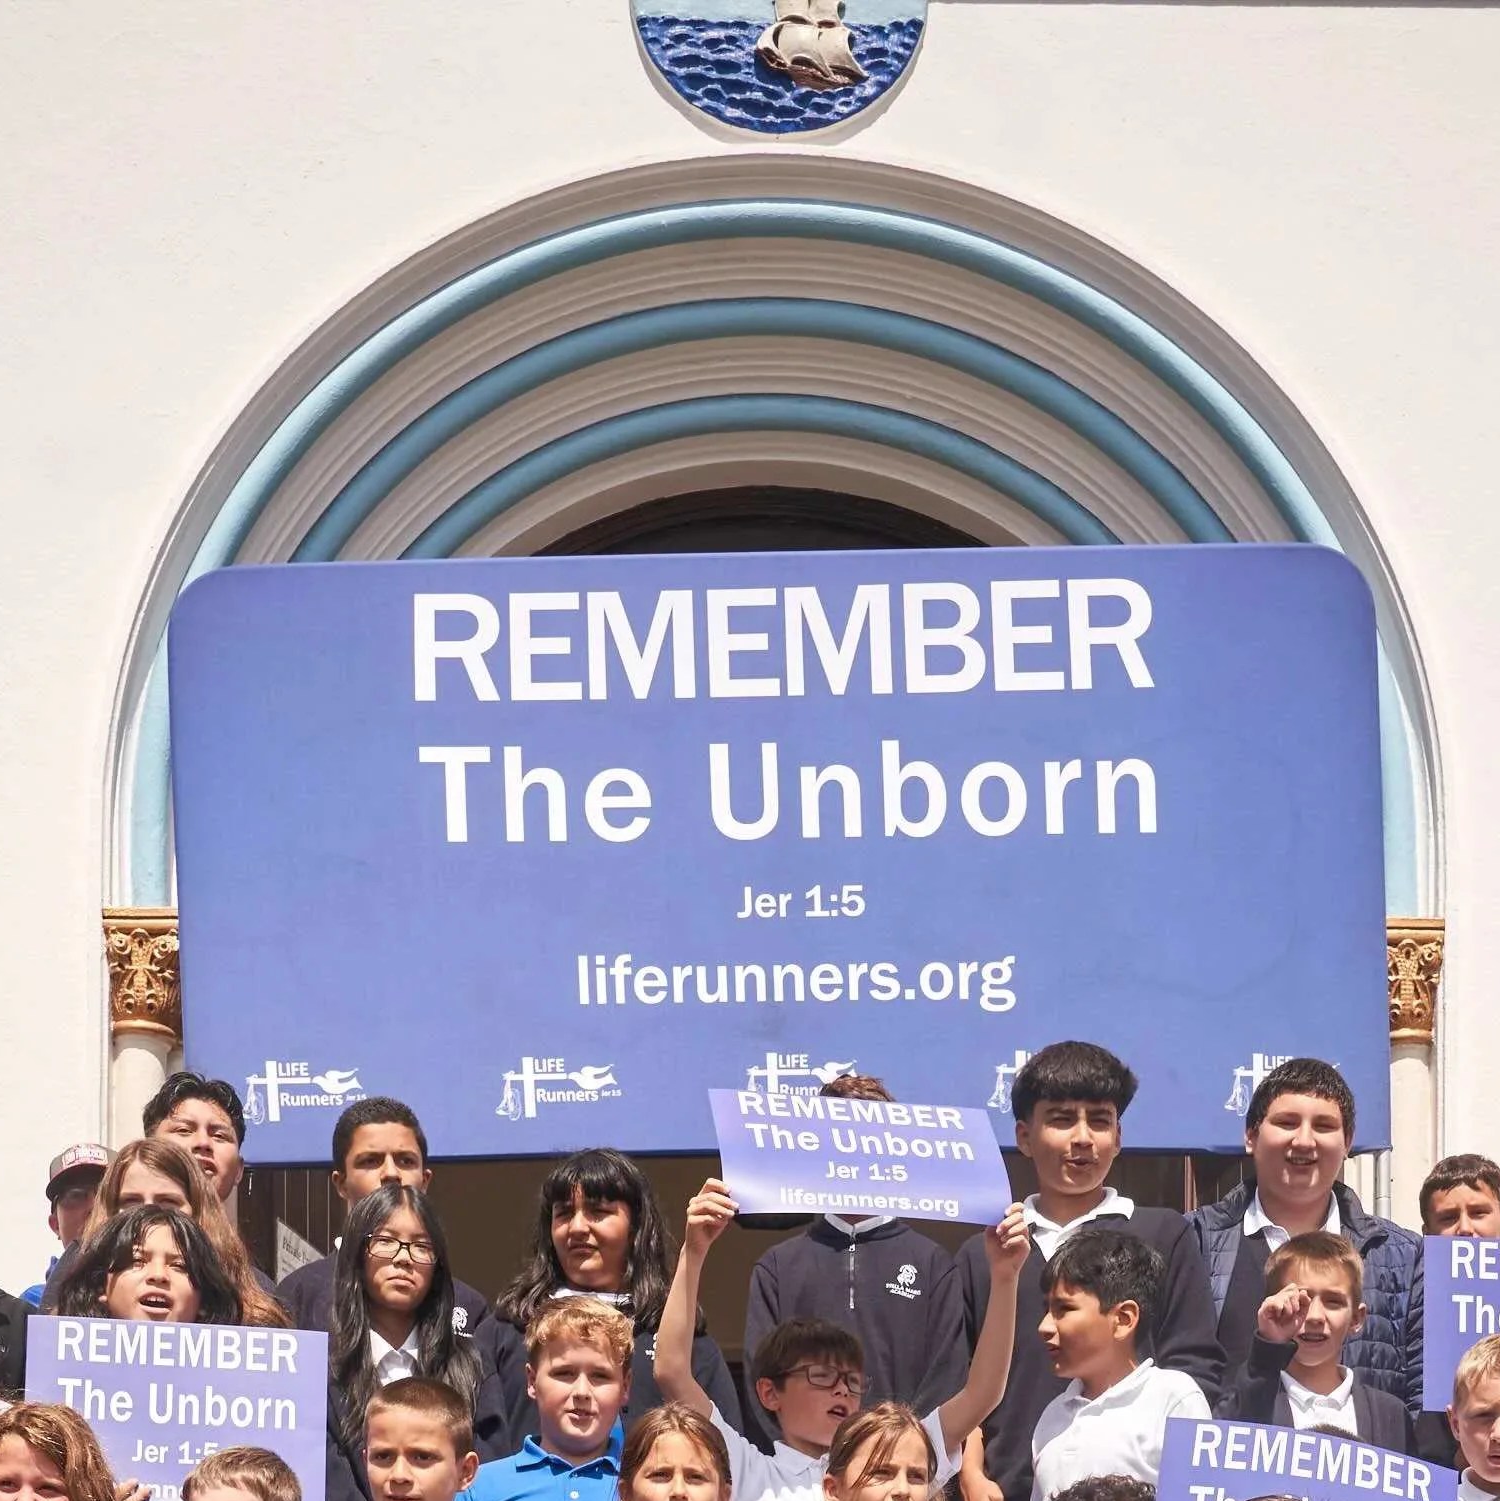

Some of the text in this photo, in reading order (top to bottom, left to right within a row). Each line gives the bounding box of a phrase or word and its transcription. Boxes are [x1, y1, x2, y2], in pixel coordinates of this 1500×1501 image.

[413, 579, 1154, 702] REMEMBER
[419, 741, 1161, 844] The Unborn
[736, 882, 866, 920] Jer 1:5
[577, 955, 1018, 1014] liferunners.org
[277, 1062, 309, 1077] LIFE
[534, 1057, 565, 1072] LIFE
[777, 1054, 809, 1069] LIFE
[279, 1092, 344, 1107] Runners
[536, 1088, 599, 1103] Runners
[736, 1090, 965, 1131] REMEMBER
[745, 1123, 975, 1162] The Unborn
[825, 1161, 908, 1183] Jer 1:5
[780, 1185, 960, 1218] liferunners.org
[57, 1320, 298, 1373] REMEMBER
[57, 1377, 297, 1430] The Unborn
[131, 1440, 168, 1464] Jer
